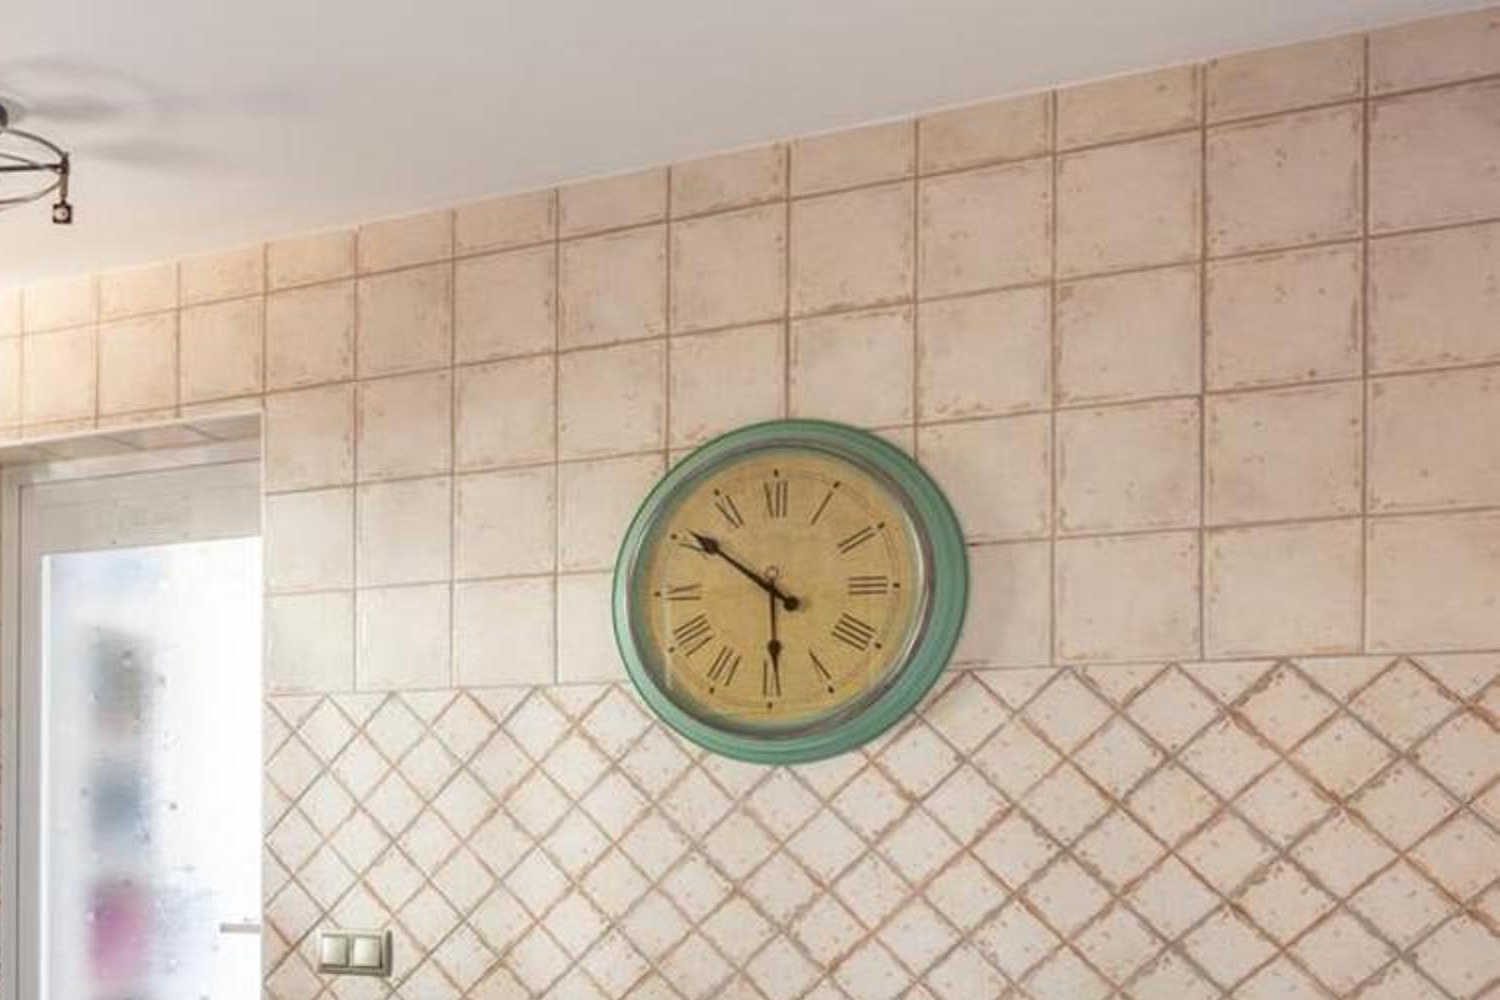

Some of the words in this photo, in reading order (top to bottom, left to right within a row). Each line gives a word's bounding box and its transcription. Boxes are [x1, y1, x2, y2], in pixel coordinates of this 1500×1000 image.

[809, 490, 835, 526] I
[836, 525, 877, 555] II
[847, 575, 889, 597] III
